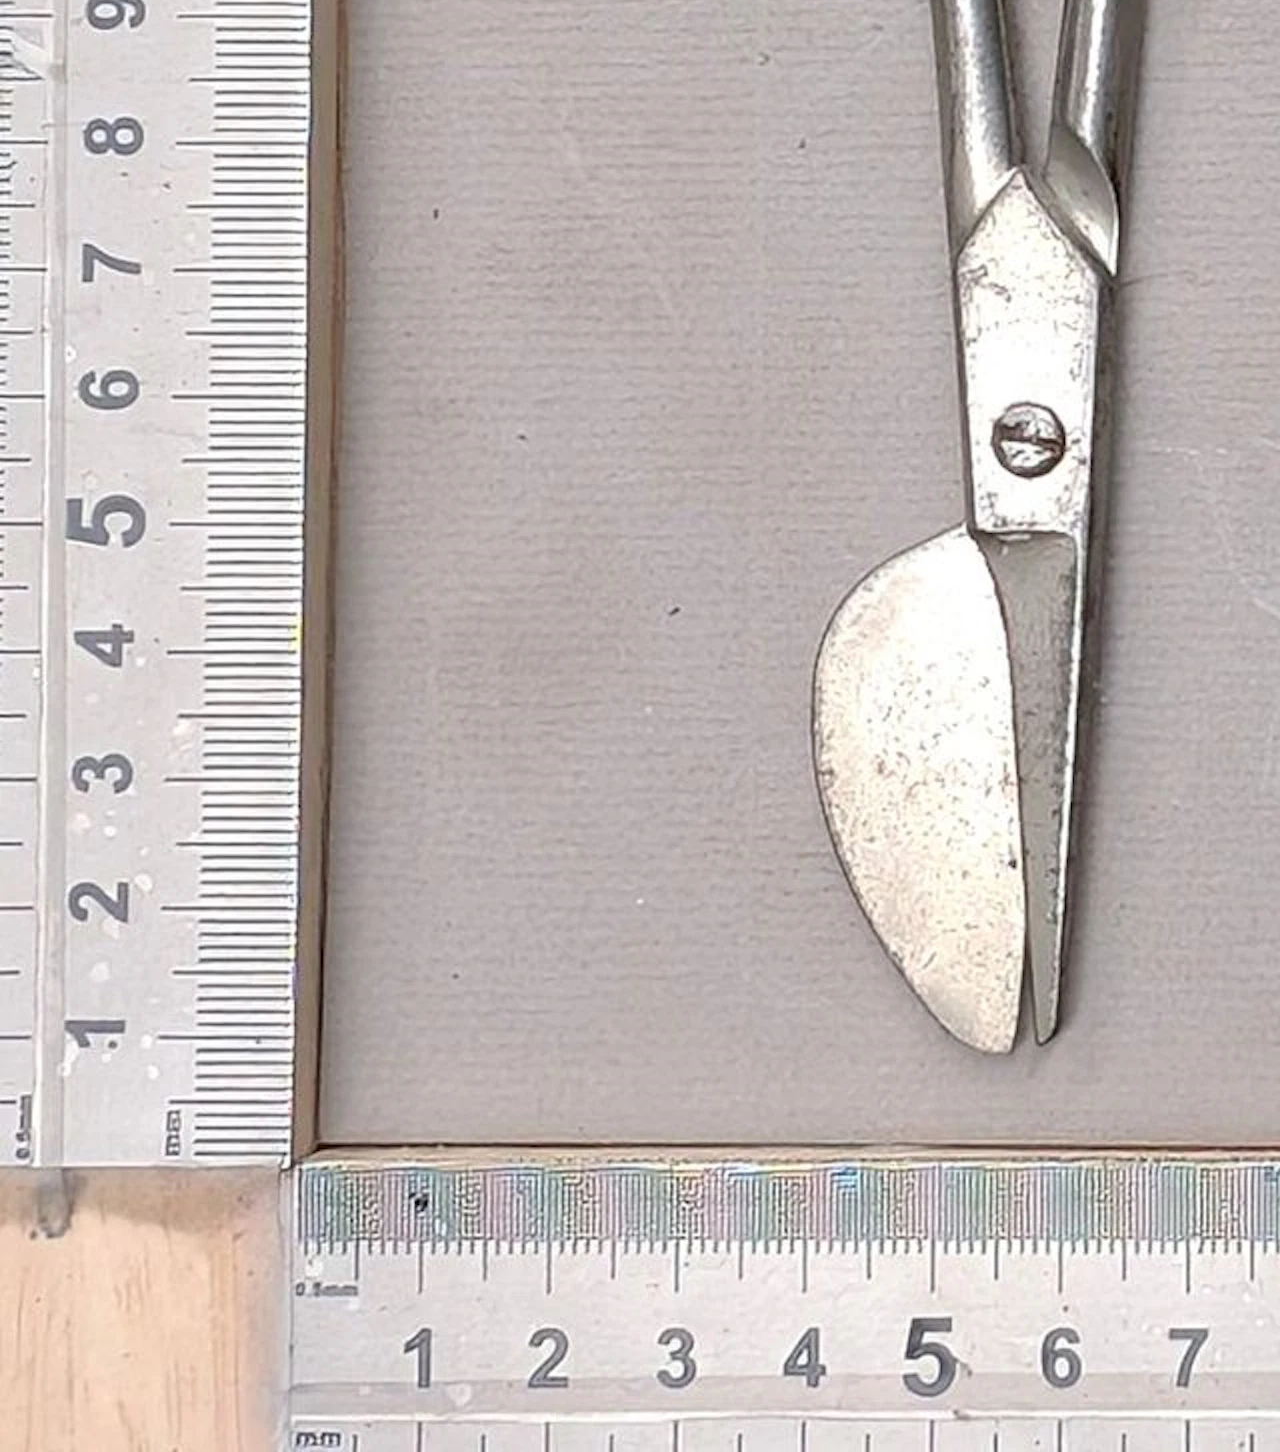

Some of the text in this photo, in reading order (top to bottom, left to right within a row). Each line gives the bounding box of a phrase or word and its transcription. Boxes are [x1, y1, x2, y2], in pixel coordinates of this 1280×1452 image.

[82, 116, 145, 157] 8
[81, 243, 142, 283] 7
[77, 369, 141, 411] 6
[64, 494, 147, 549] 5
[73, 623, 136, 668] 4
[71, 753, 134, 795] 3
[68, 881, 131, 924] 2
[64, 1019, 127, 1049] 1
[402, 1327, 434, 1390] 1
[526, 1327, 570, 1390] 2
[656, 1327, 697, 1390] 3
[782, 1326, 827, 1389] 4
[901, 1315, 957, 1399] 5
[1039, 1327, 1083, 1390] 6
[1167, 1327, 1210, 1390] 7
[295, 1432, 341, 1448] mm
